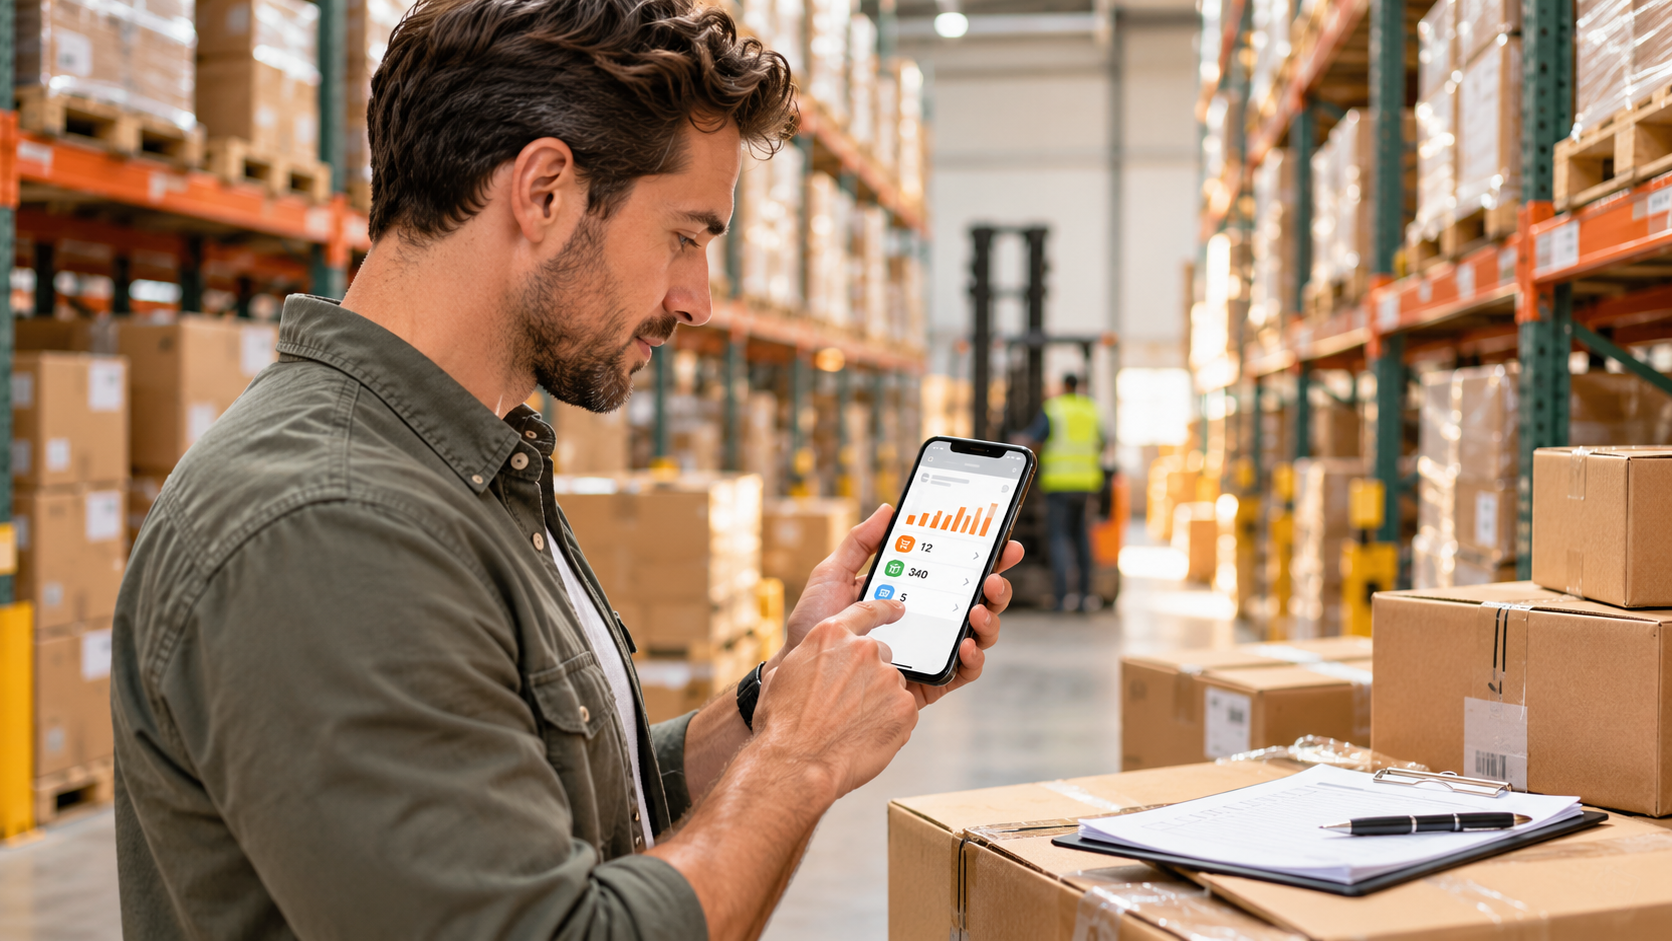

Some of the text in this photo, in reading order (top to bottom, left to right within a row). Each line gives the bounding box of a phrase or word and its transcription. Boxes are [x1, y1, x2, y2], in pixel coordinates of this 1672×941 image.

[921, 542, 933, 553] 12
[908, 567, 928, 579] 340
[899, 592, 908, 602] 5
